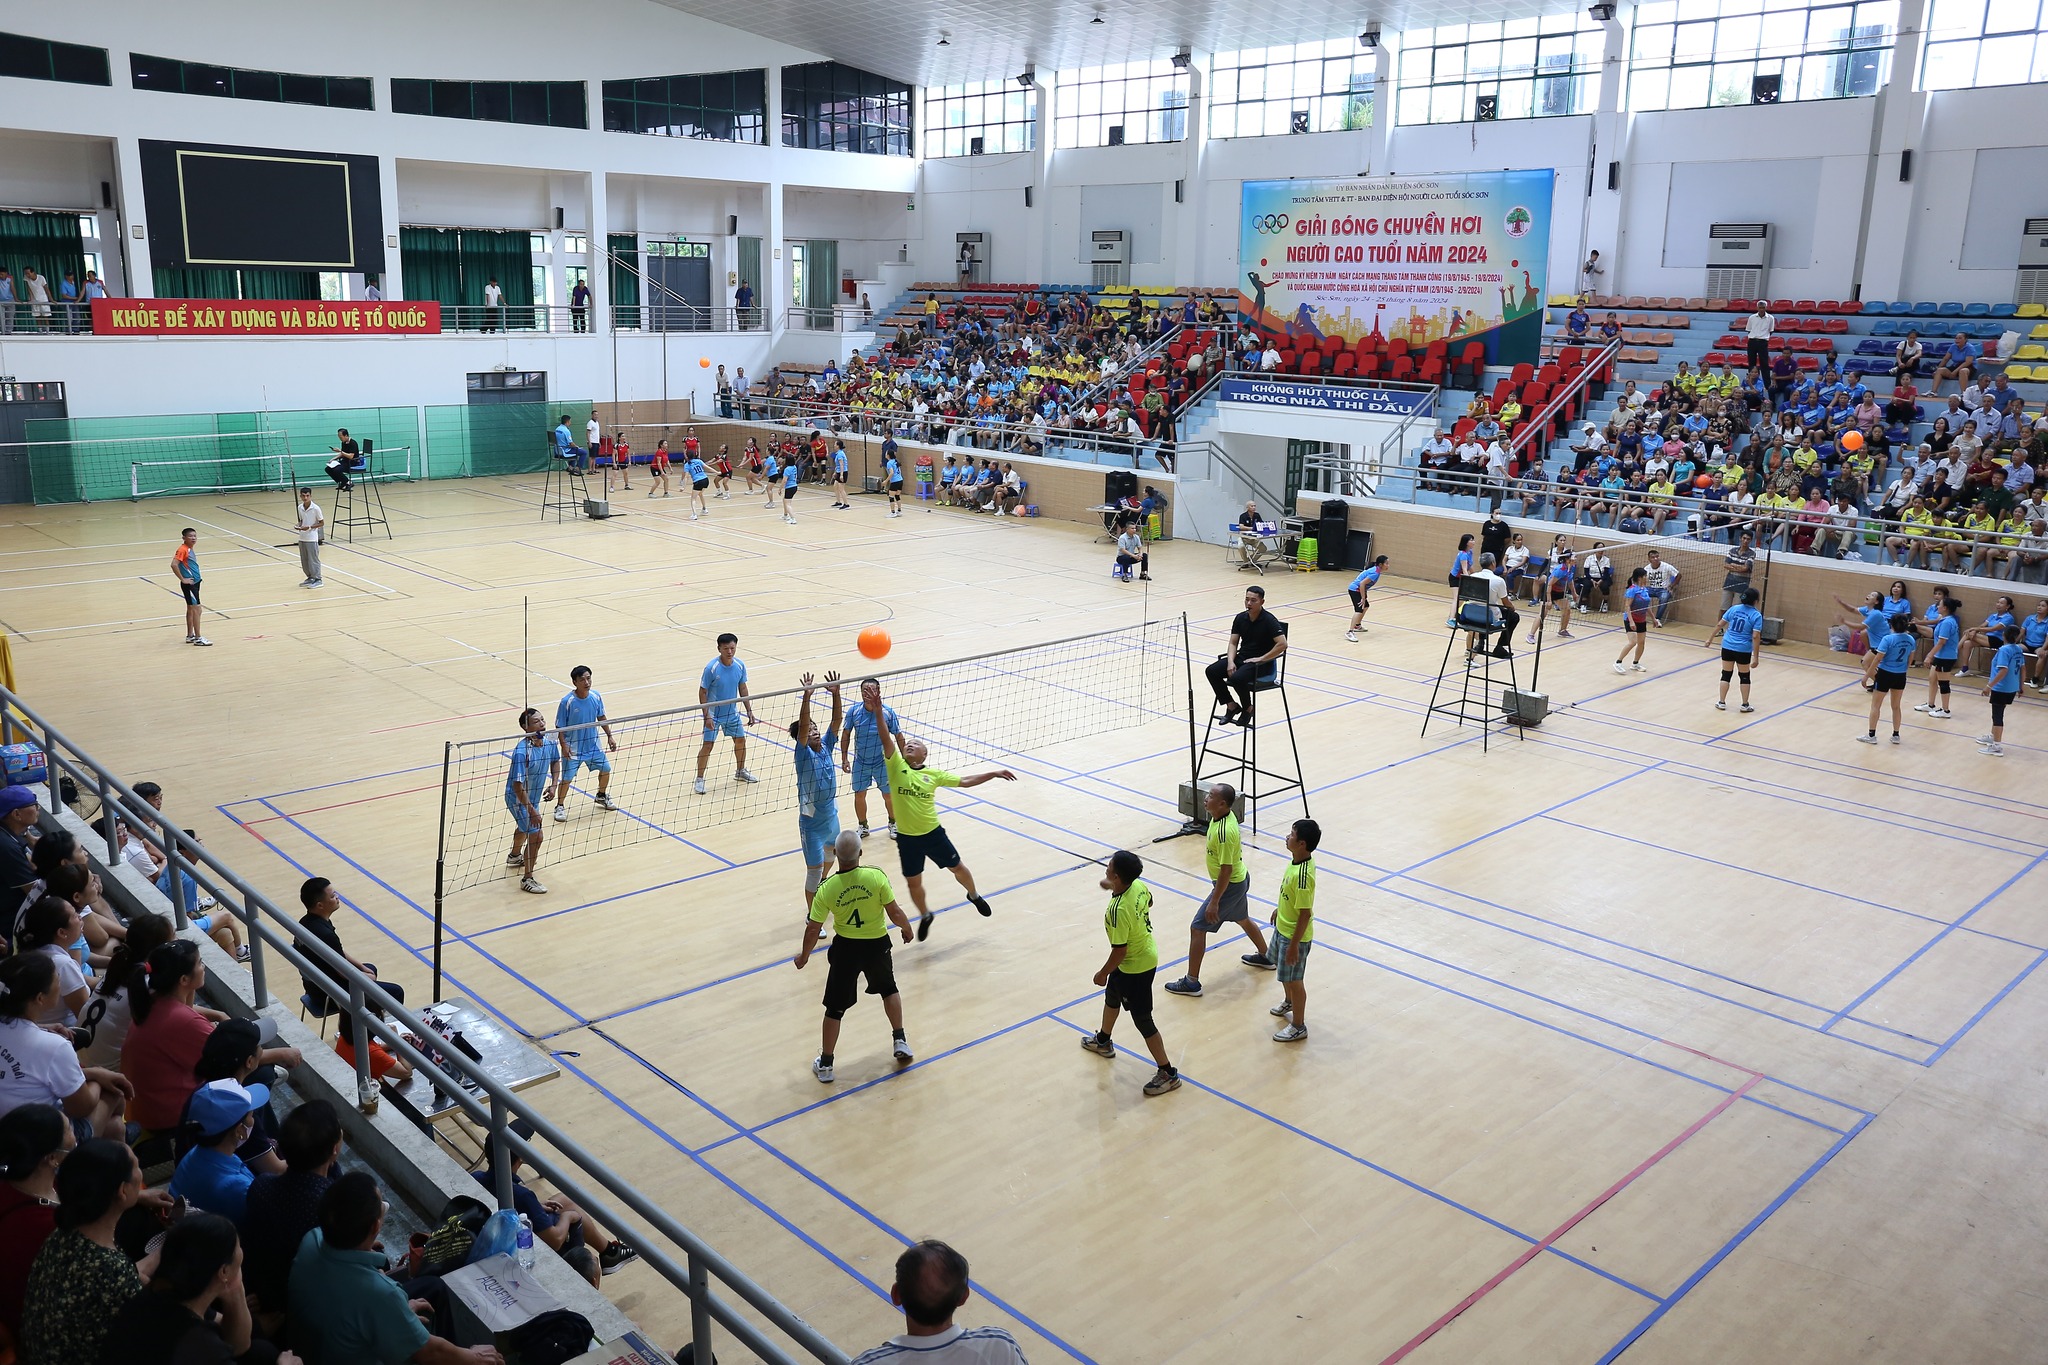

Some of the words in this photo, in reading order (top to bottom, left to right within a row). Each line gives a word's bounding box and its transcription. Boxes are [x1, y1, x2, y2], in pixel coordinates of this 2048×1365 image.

[1383, 193, 1397, 202] DIỆN
[1398, 193, 1409, 202] HỘI
[1411, 192, 1429, 200] NGƯỜI
[1445, 190, 1461, 199] TUỔI
[1462, 191, 1474, 199] SÓC
[1476, 191, 1489, 199] SƠN
[1295, 213, 1327, 236] GIẢI
[1331, 214, 1379, 236] BÓNG
[1383, 211, 1445, 235] CHUYỀN
[1450, 215, 1482, 234] HƠI
[1287, 242, 1330, 262] NGƯỜI
[1334, 246, 1364, 263] CAO
[1368, 239, 1401, 263] TUỔI
[1406, 242, 1443, 263] NĂM
[1447, 246, 1488, 263] 2024
[112, 302, 160, 328] KHỎE
[164, 303, 188, 328] ĐỂ
[193, 306, 226, 328] XÂY
[231, 308, 276, 331] DỰNG
[280, 307, 302, 328] VÀ
[306, 304, 338, 328] BẢO
[342, 307, 361, 331] VỆ
[364, 304, 383, 328] TỔ
[387, 306, 427, 329] QUỐC
[1230, 392, 1286, 404] TRONG
[1290, 395, 1329, 407] NHÀ
[1333, 400, 1363, 410] THI
[1368, 402, 1412, 413] ĐẤU
[1251, 384, 1294, 395] KHÔNG
[1298, 387, 1323, 397] HÚT
[1325, 390, 1369, 400] THUỐC
[1373, 392, 1390, 402] LÁ
[1732, 616, 1745, 633] 10
[1896, 648, 1906, 662] 2
[846, 909, 864, 928] 4
[1, 1049, 14, 1063] Cao
[476, 1274, 518, 1310] AQUAFINA
